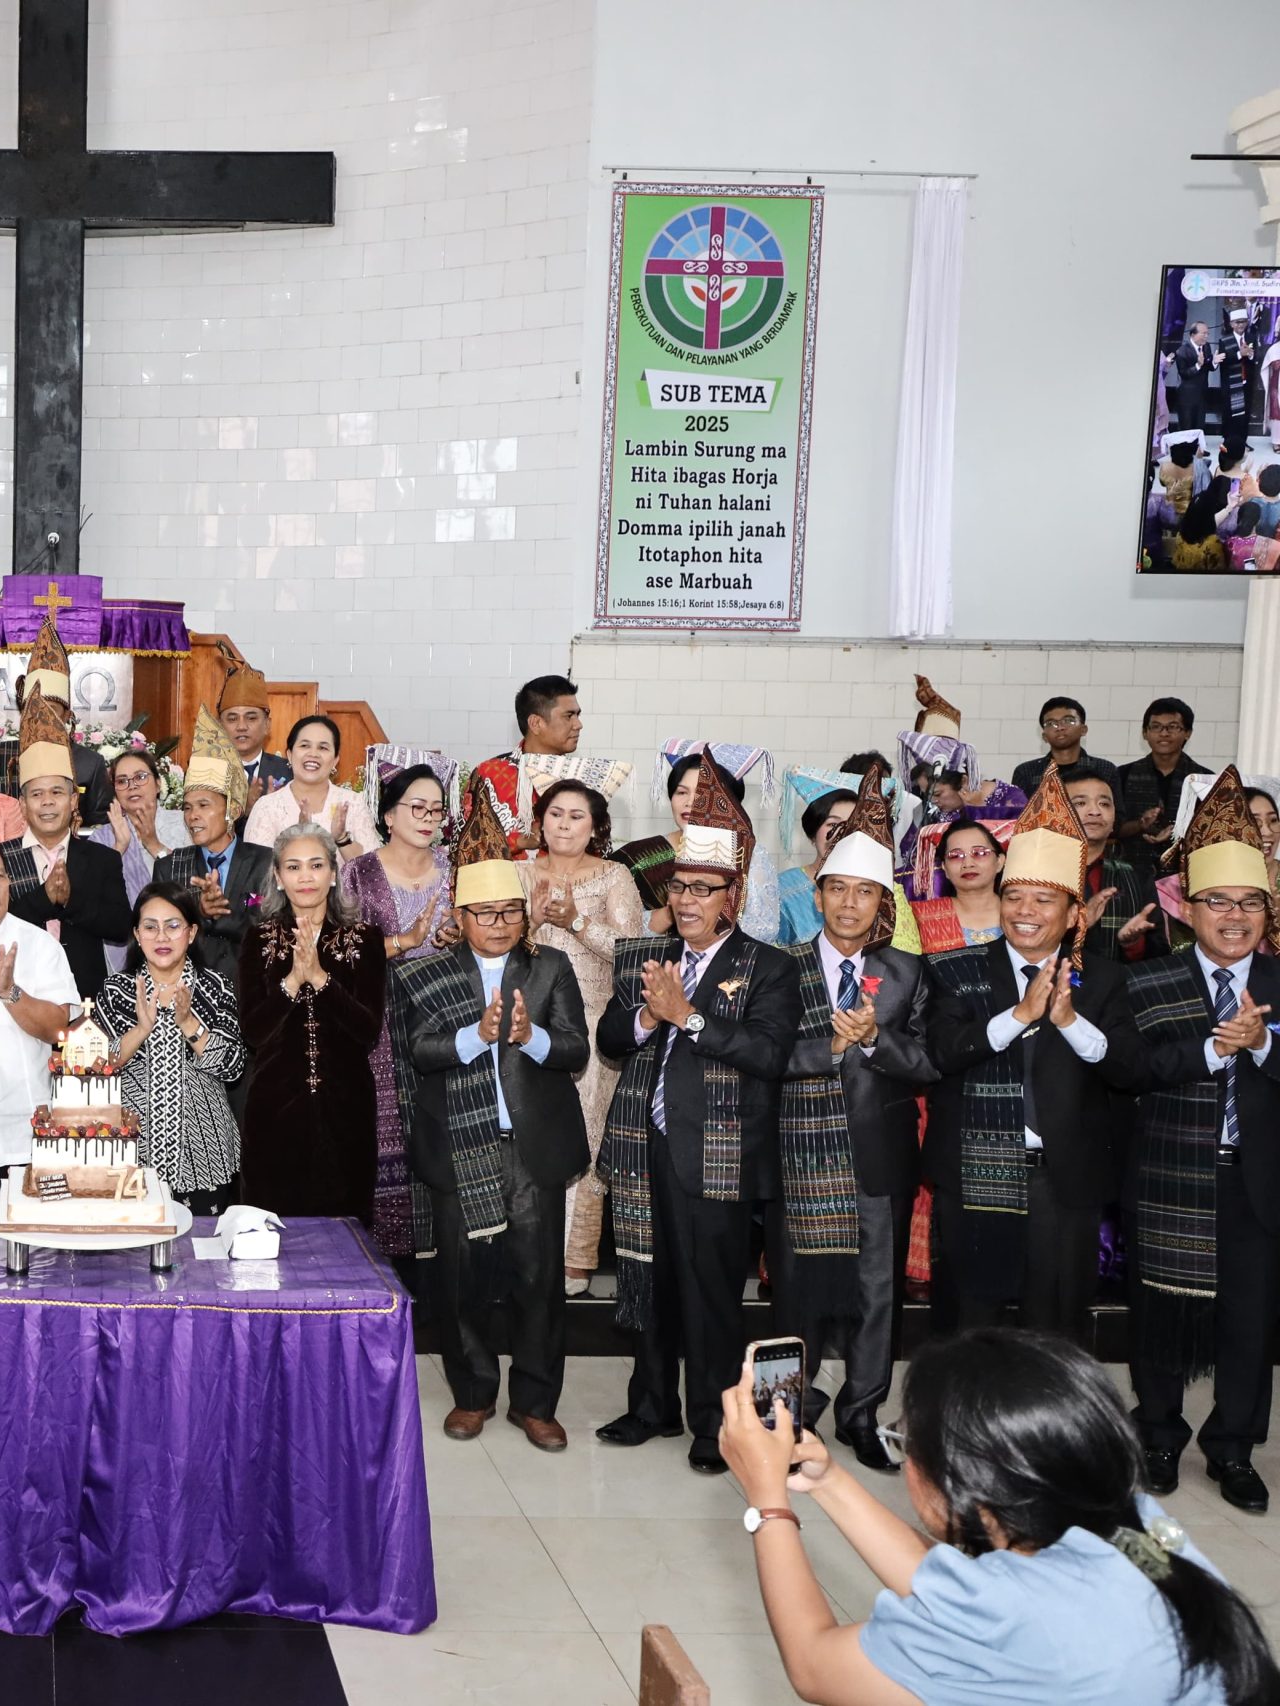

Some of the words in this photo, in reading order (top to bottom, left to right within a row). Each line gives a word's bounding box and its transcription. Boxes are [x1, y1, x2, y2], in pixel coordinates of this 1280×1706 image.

[630, 288, 667, 347] PERSEKUTUAN
[665, 343, 684, 360] DAN
[685, 352, 739, 366] PELAYANAN
[739, 342, 764, 359] YANG
[762, 291, 798, 344] BERDAMPAK
[661, 384, 701, 402] SUB
[708, 385, 766, 403] TEMA
[685, 416, 728, 432] 2025
[625, 440, 687, 456] Lambin
[695, 441, 755, 462] Surung
[762, 447, 786, 458] ma
[631, 466, 666, 482] Hita
[674, 467, 725, 488] ibagas
[732, 468, 777, 489] Horja
[636, 493, 651, 509] ni
[659, 493, 711, 510] Tuhan
[719, 494, 770, 510] halani
[618, 519, 682, 535] Domma
[689, 520, 733, 541] ipilih
[738, 521, 785, 541] janah
[639, 546, 722, 567] Itotaphon
[729, 547, 762, 563] hita
[646, 577, 672, 588] ase
[680, 573, 752, 589] Marbuah
[769, 601, 785, 610] 6:8)
[107, 1168, 147, 1201] 74
